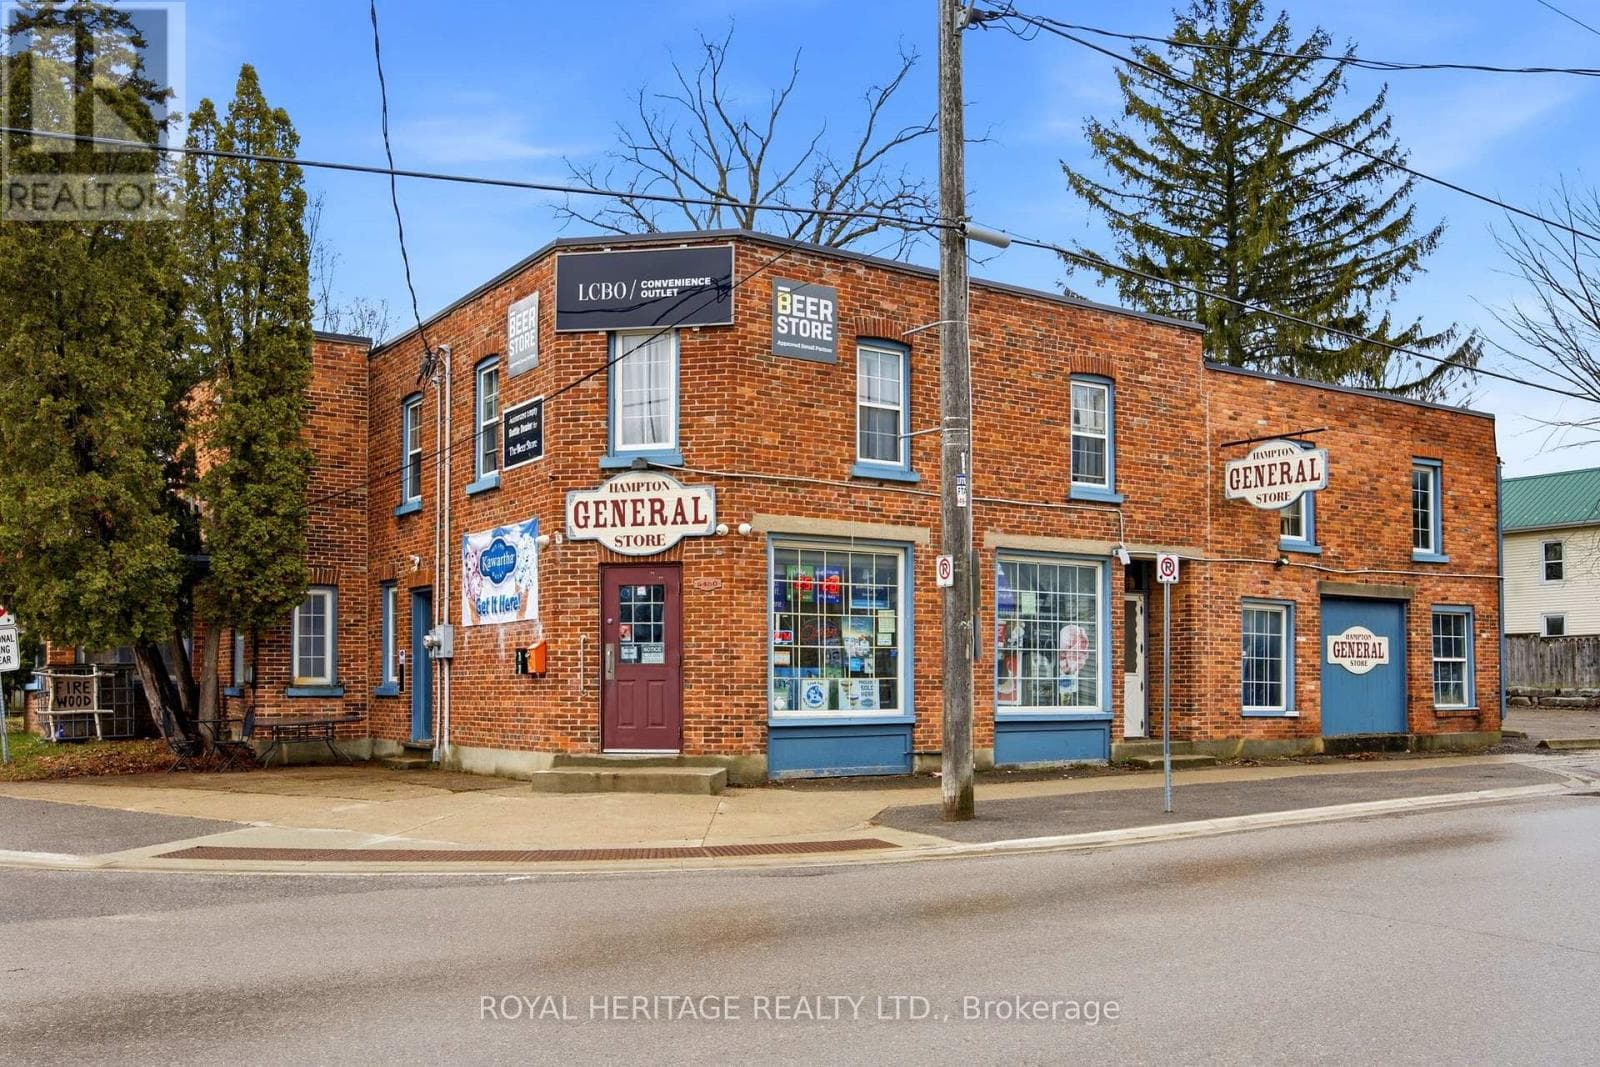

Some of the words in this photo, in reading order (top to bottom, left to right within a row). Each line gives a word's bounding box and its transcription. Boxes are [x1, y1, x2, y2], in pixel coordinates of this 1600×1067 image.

[578, 282, 627, 301] LCBO
[641, 277, 712, 289] CONVENIENCE
[641, 288, 679, 298] OUTLET
[777, 286, 833, 322] BEER
[509, 306, 536, 338] BEER
[777, 315, 833, 341] STORE
[509, 330, 536, 357] STORE
[1253, 447, 1295, 460] HAMPTON
[1229, 458, 1321, 491] GENERAL
[609, 481, 671, 493] HAMPTON
[1256, 491, 1292, 504] STORE
[573, 496, 708, 529] GENERAL
[614, 534, 666, 547] STORE
[482, 550, 516, 572] Kawartha
[476, 597, 490, 615] Get
[1333, 641, 1385, 659] GENERAL
[56, 681, 91, 694] FIRE
[57, 696, 91, 707] WOOD
